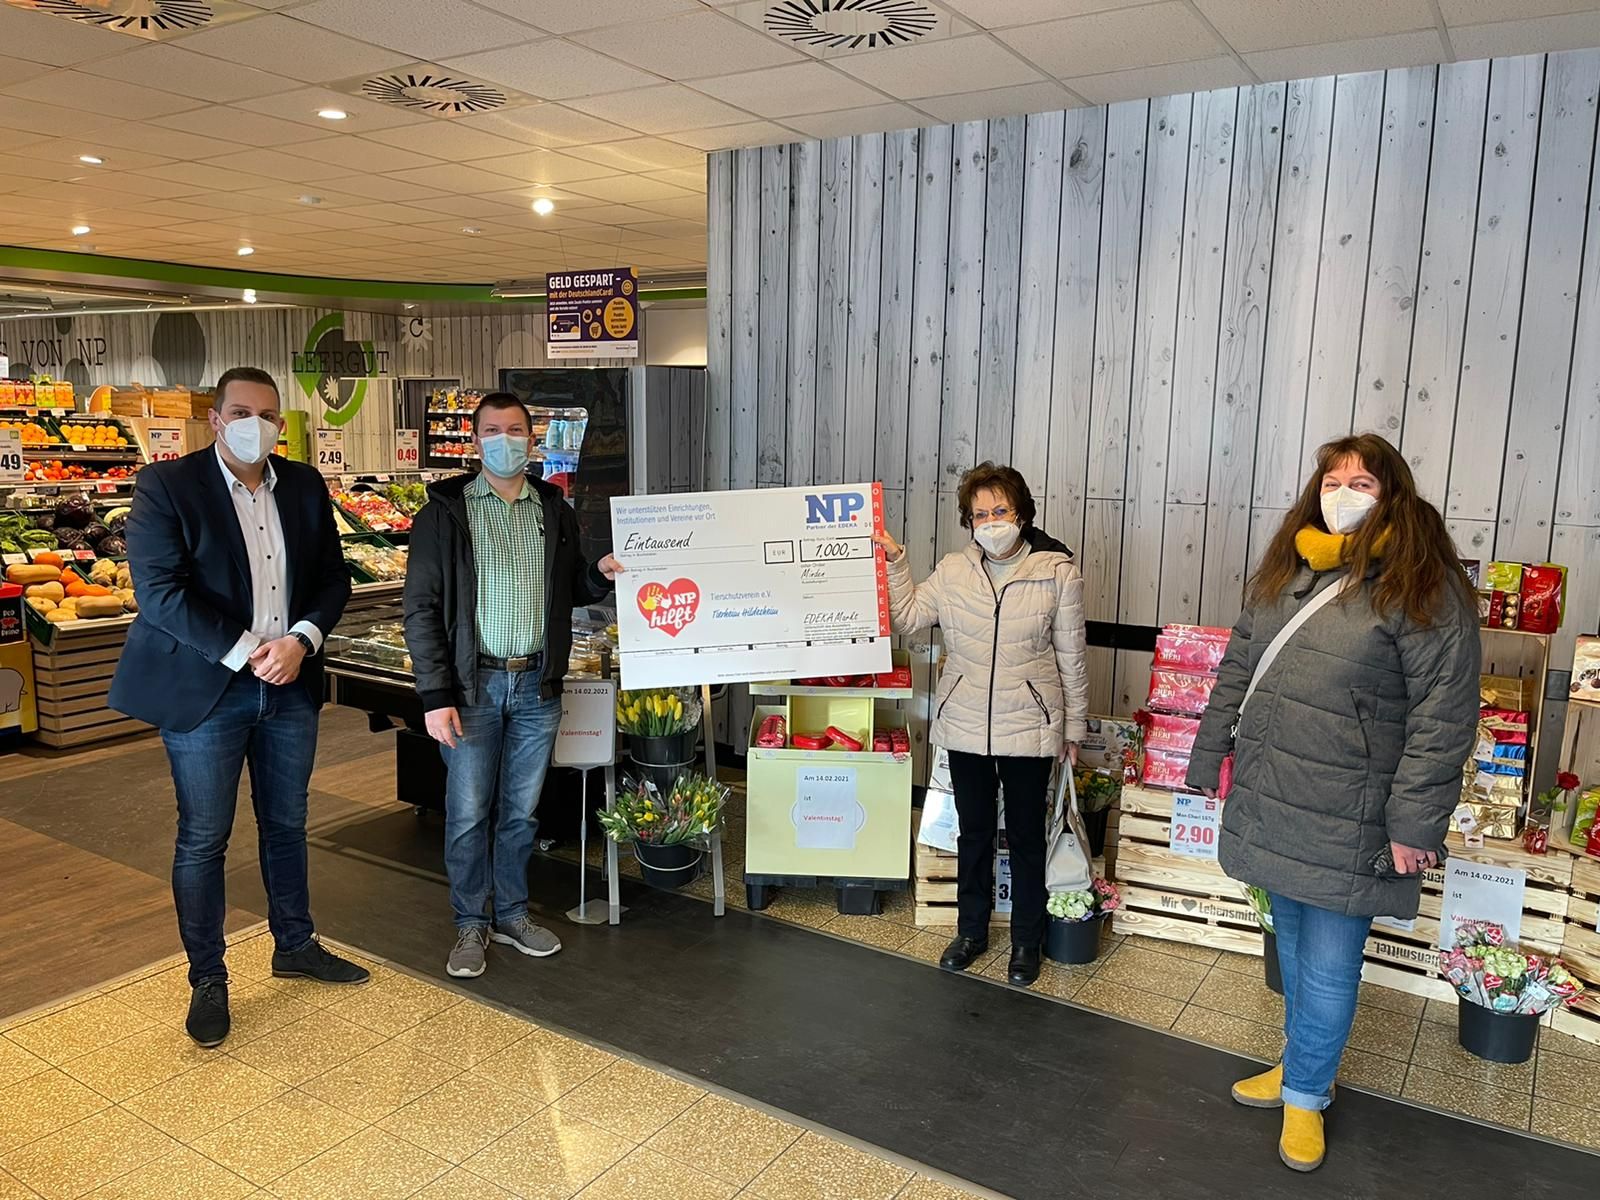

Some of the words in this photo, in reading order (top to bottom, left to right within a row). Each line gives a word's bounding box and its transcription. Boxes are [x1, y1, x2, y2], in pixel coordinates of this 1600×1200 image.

[549, 276, 572, 289] GELD
[574, 273, 614, 287] GESPART
[22, 339, 63, 368] VON
[78, 338, 107, 367] NP
[291, 351, 389, 373] LEERGUT
[0, 453, 21, 470] 49
[319, 450, 342, 465] 2,49
[397, 448, 418, 461] 0,49
[616, 506, 627, 515] Wir
[628, 504, 667, 514] unterstützen
[668, 503, 713, 513] Einrichtungen,
[617, 516, 656, 525] Institutionen
[657, 515, 670, 523] und
[670, 513, 694, 522] Vereine
[705, 512, 716, 520] Ort
[806, 523, 827, 531] Partner
[838, 522, 858, 530] EDEKA
[624, 530, 694, 551] Eintausend
[674, 592, 697, 606] NP
[711, 591, 759, 601] Tierschutzverein
[650, 606, 696, 629] hilft
[803, 612, 834, 624] EDEKA
[560, 729, 602, 737] Valentinstag!
[1177, 797, 1191, 806] NP
[803, 815, 844, 823] Valentinstag!
[1175, 823, 1214, 845] 2,90
[1454, 868, 1469, 877] Am
[1470, 871, 1515, 886] 14.02.2021
[999, 883, 1009, 899] 3
[1452, 890, 1462, 899] ist
[1161, 895, 1179, 909] Wir
[1199, 901, 1259, 922] Lebensmitt
